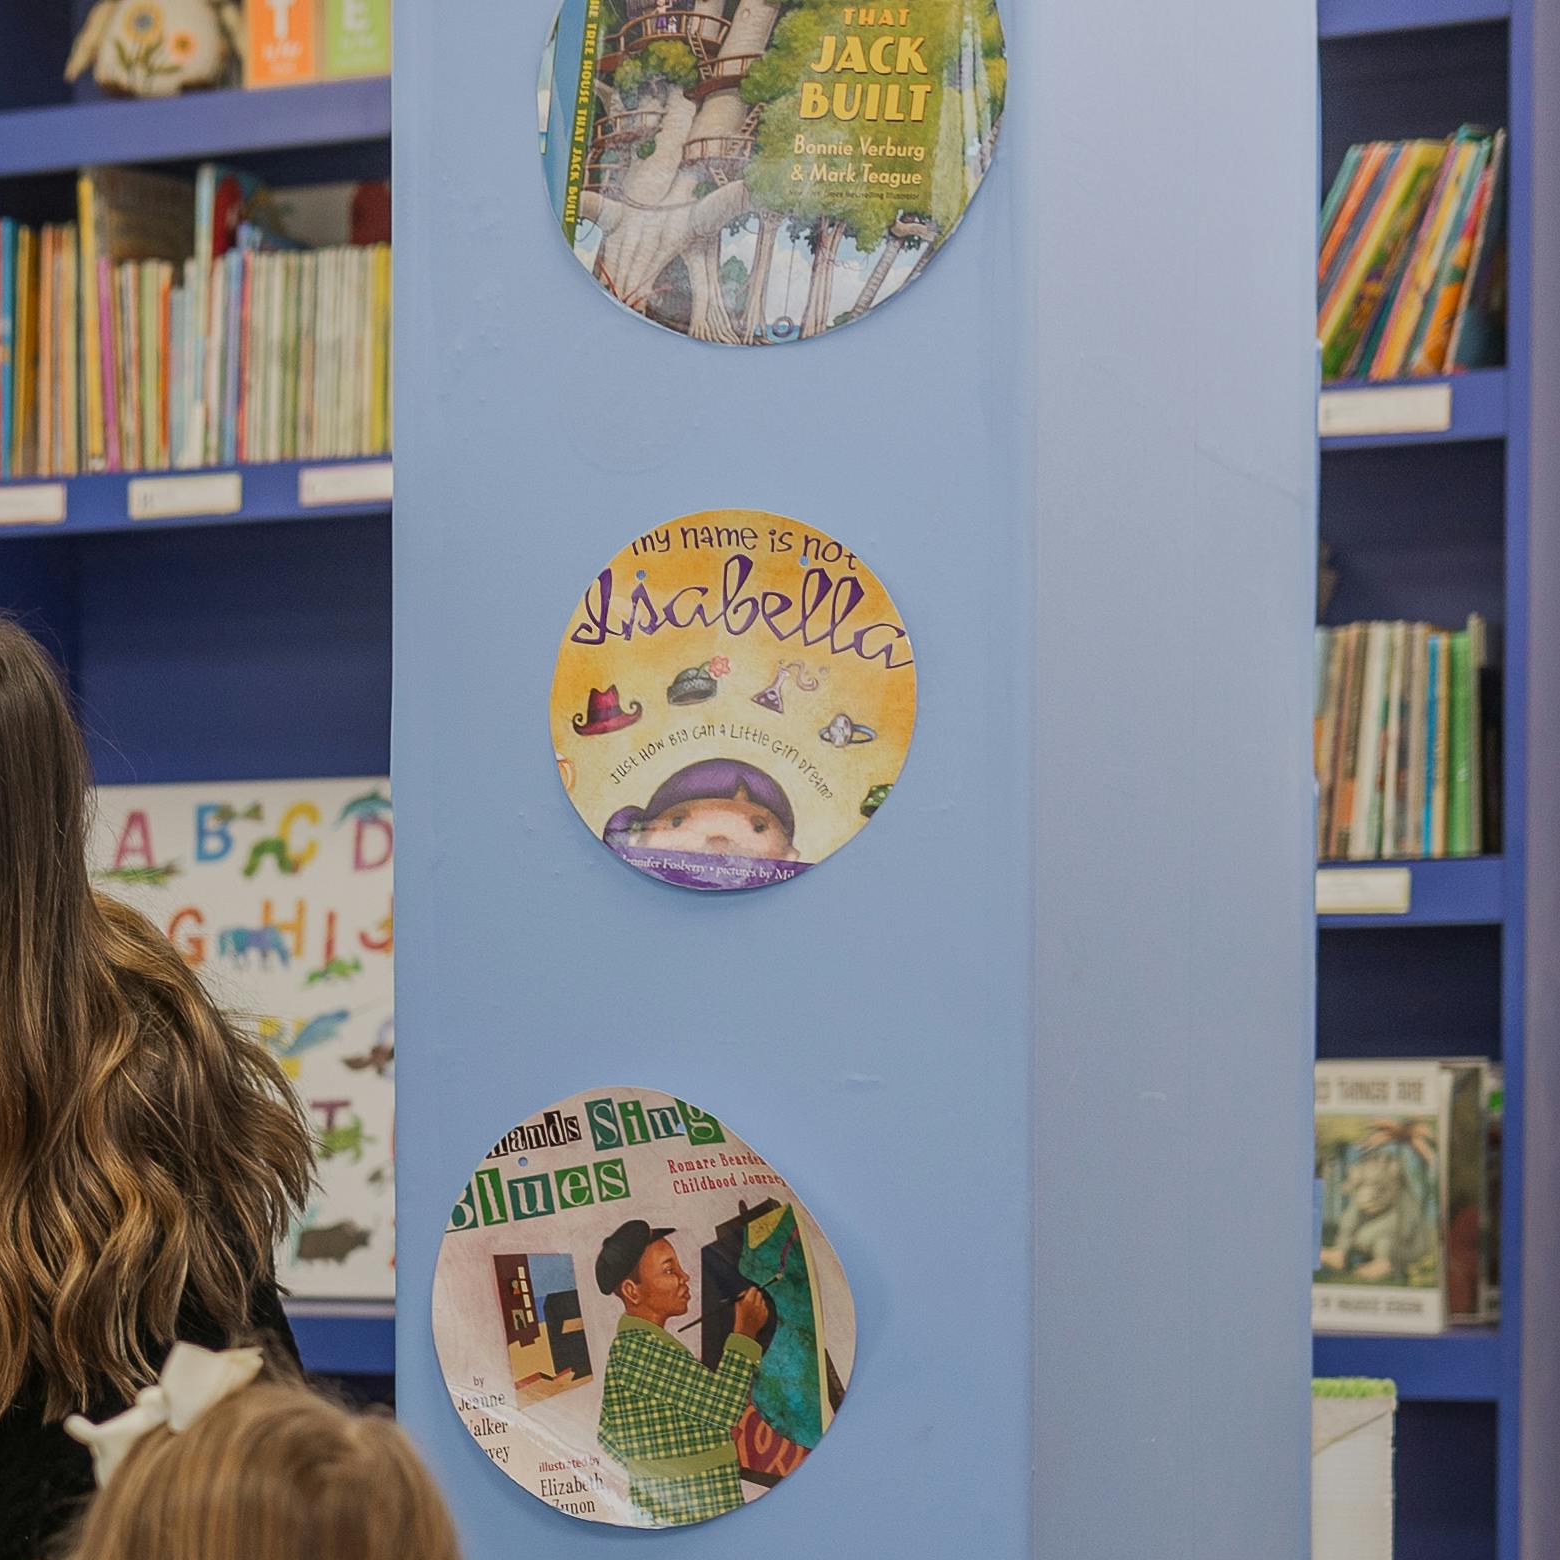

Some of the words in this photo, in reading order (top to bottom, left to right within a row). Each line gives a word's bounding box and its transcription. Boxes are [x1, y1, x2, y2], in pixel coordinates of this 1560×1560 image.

[844, 8, 910, 26] THAT
[585, 23, 597, 55] TREE
[810, 36, 928, 74] JACK
[580, 61, 593, 104] HOUSE
[799, 82, 932, 121] BUILT
[575, 107, 588, 143] THAT
[570, 150, 582, 181] JACK
[794, 134, 853, 155] Bonnie
[860, 136, 924, 161] Verburg
[790, 164, 804, 181] &
[809, 163, 856, 183] Mark
[862, 164, 923, 188] Teague
[565, 186, 579, 224] BUILT
[681, 525, 758, 550] name
[768, 529, 793, 553] is
[802, 535, 858, 571] not
[571, 554, 915, 670] Isabella
[113, 810, 154, 869] A
[195, 803, 235, 862] B
[280, 803, 321, 870] C
[353, 814, 394, 871] D
[167, 906, 206, 966] G
[593, 1103, 715, 1145] Sing
[667, 1157, 716, 1174] Romare
[673, 1171, 737, 1195] Childhood
[447, 1164, 626, 1230] Blues
[473, 1376, 485, 1388] by
[469, 1418, 509, 1437] alker
